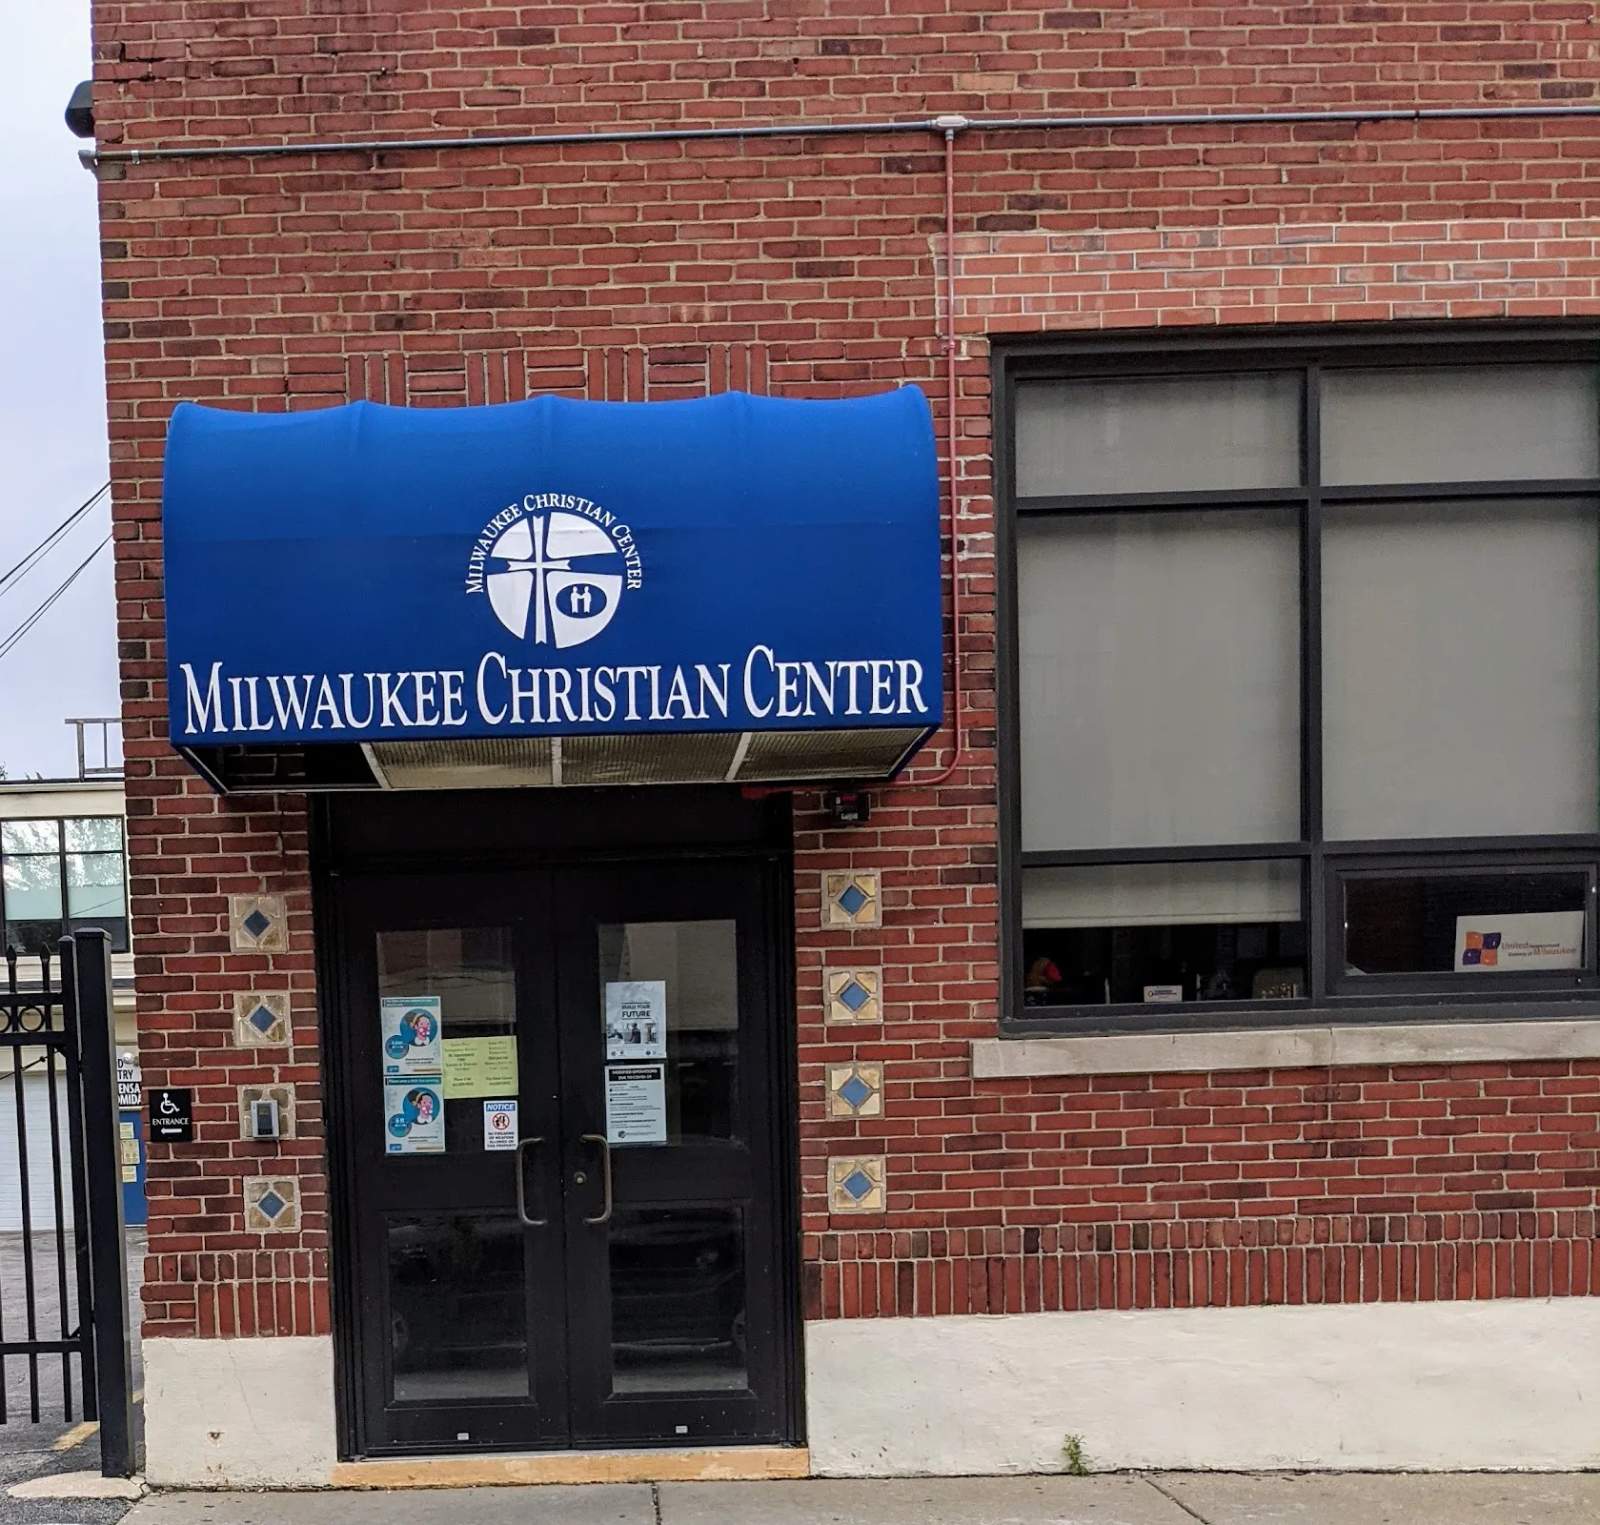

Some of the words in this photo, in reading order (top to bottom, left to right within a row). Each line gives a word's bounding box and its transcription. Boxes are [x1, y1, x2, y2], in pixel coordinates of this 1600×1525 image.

[465, 503, 522, 594] MILWAUKEE
[523, 493, 617, 528] CHRISTIAN
[611, 524, 643, 590] CENTER
[179, 661, 468, 734] MILWAUKEE
[476, 651, 731, 725] CHRISTIAN
[743, 644, 929, 718] CENTER
[152, 1117, 189, 1126] ENTRANCE
